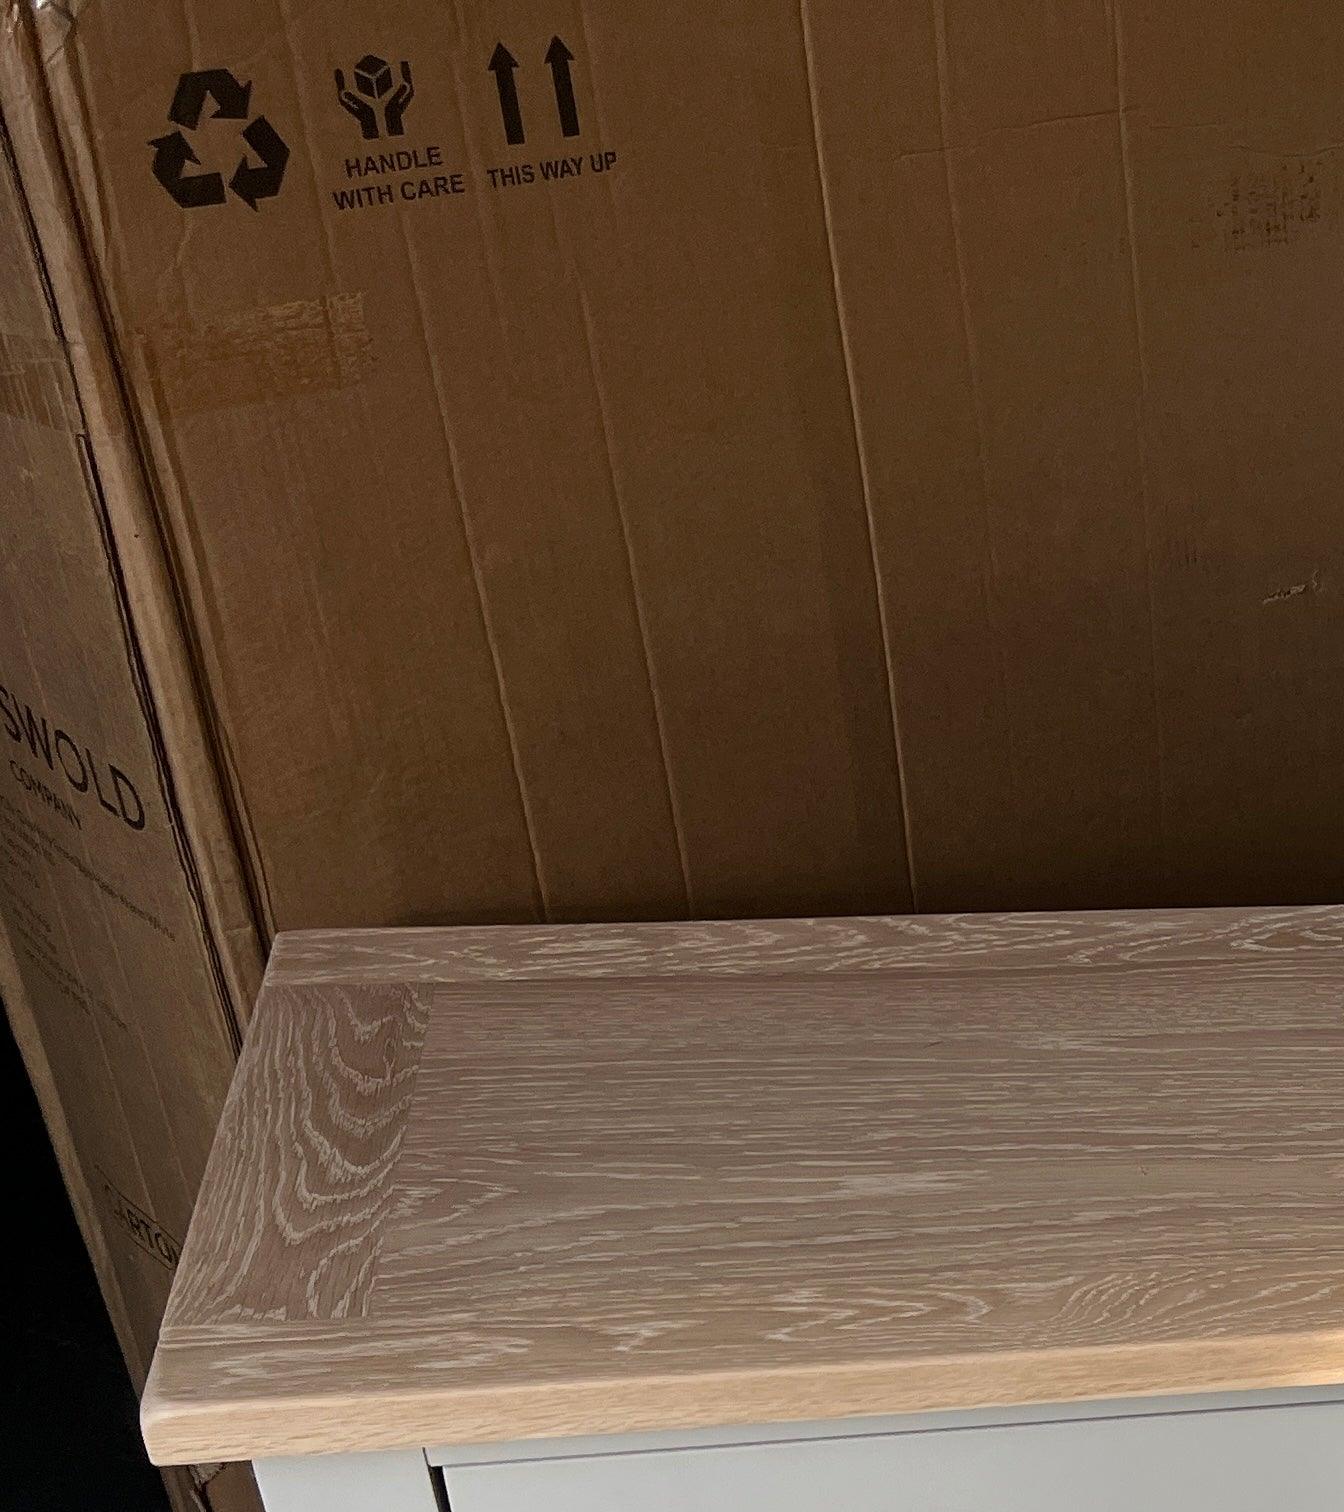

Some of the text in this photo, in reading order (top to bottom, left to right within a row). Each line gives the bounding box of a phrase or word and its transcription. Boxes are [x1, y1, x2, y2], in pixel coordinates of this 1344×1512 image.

[345, 147, 443, 178] HANDLE
[487, 151, 617, 188] THIS WAY UP
[333, 174, 465, 210] WITH CARE
[9, 760, 82, 830] COMPANY
